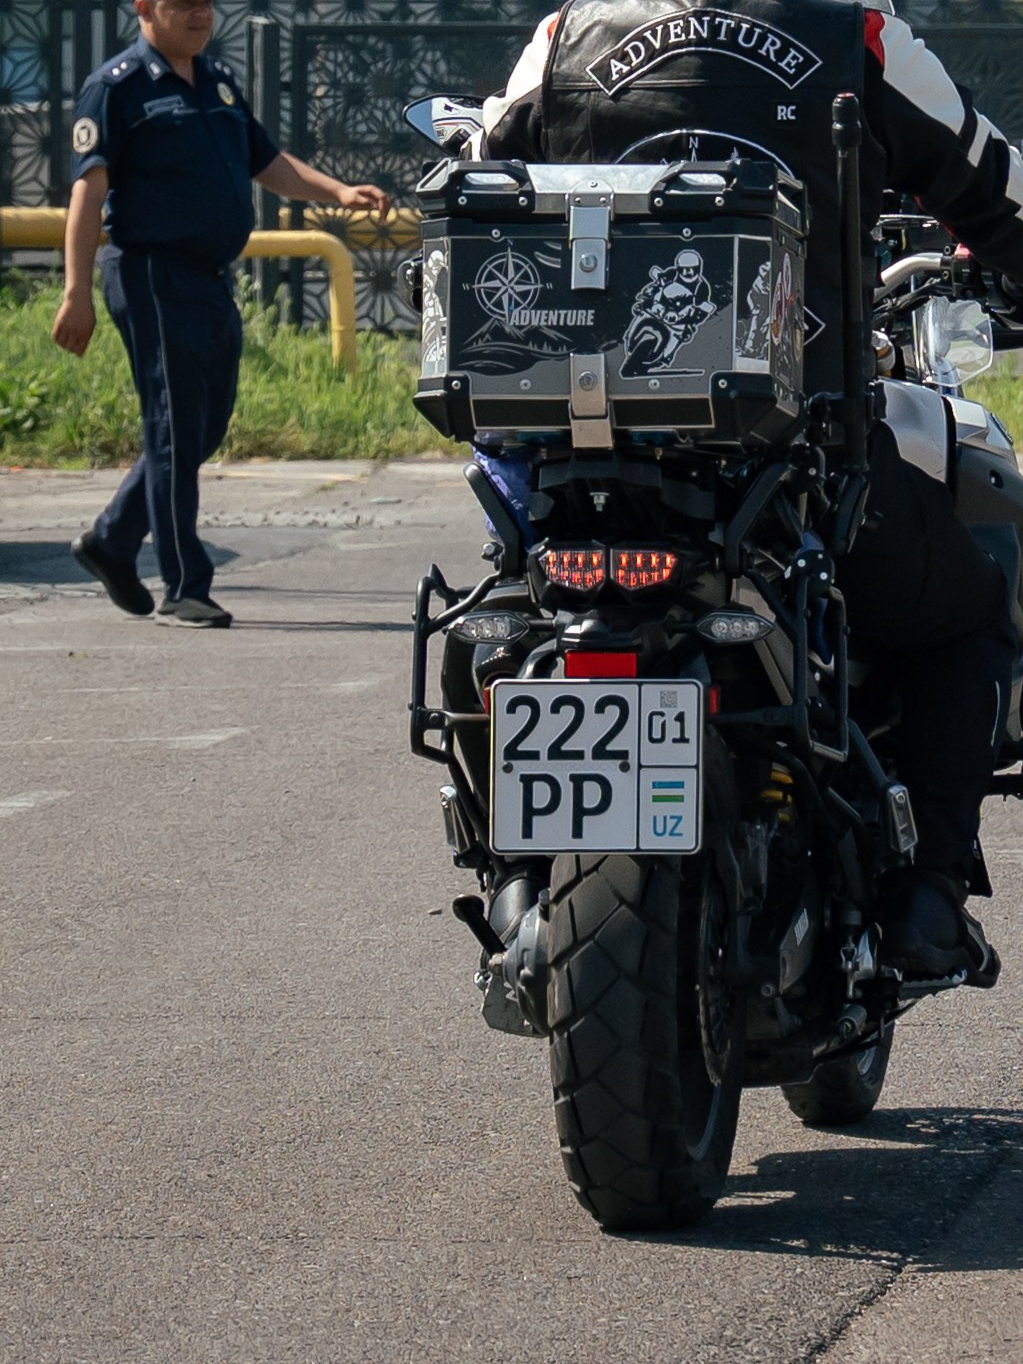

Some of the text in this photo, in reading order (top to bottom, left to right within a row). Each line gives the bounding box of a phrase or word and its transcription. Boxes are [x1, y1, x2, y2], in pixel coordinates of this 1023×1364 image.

[608, 16, 804, 81] ADVENTURE
[777, 105, 796, 120] RC
[689, 137, 699, 149] N
[509, 309, 596, 326] ADVENTURE
[503, 694, 690, 761] 222 01
[518, 773, 613, 840] PP
[652, 815, 683, 837] UZ
